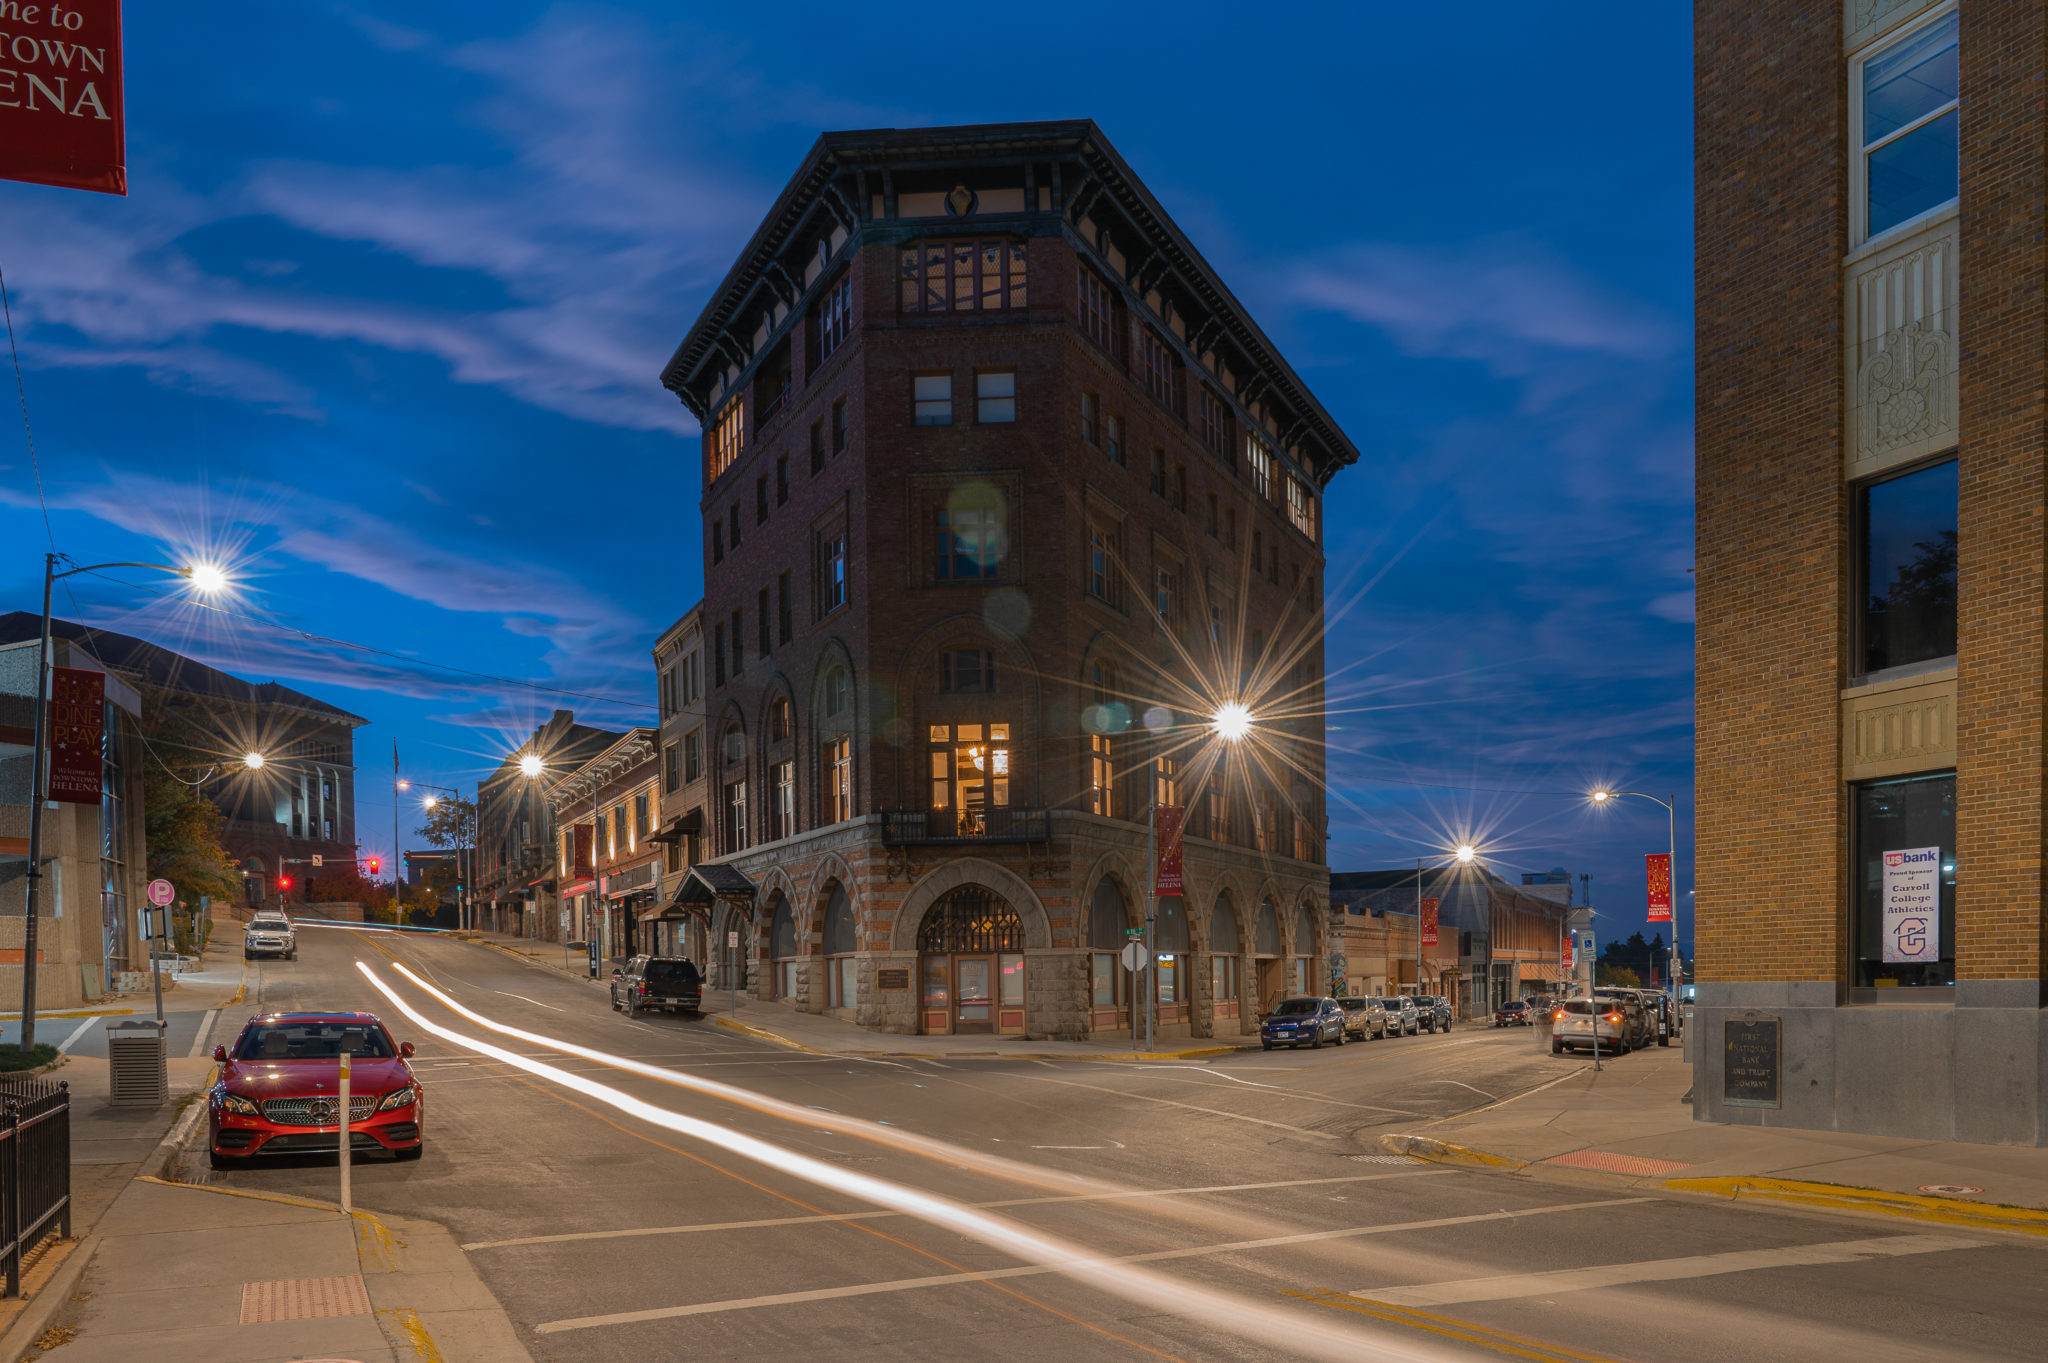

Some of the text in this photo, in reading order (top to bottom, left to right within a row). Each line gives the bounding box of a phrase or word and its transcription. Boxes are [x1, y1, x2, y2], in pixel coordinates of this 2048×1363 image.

[51, 3, 83, 31] to
[56, 703, 99, 726] DINE
[54, 726, 99, 746] PLAY
[57, 767, 86, 776] Welcome
[53, 775, 99, 784] DOWNTOWN
[52, 781, 99, 793] HELENA
[1908, 868, 1933, 876] Sponsor
[1648, 872, 1668, 882] DINE
[154, 882, 170, 902] P
[1648, 883, 1668, 893] PLAY
[1892, 883, 1930, 892] Carroll
[1891, 895, 1931, 903] College
[1887, 905, 1935, 914] Athletics
[1741, 1032, 1761, 1041] FIRST
[1733, 1045, 1769, 1053] NATIONAL
[1741, 1056, 1760, 1064] BANK
[1732, 1068, 1771, 1077] AND TRUST
